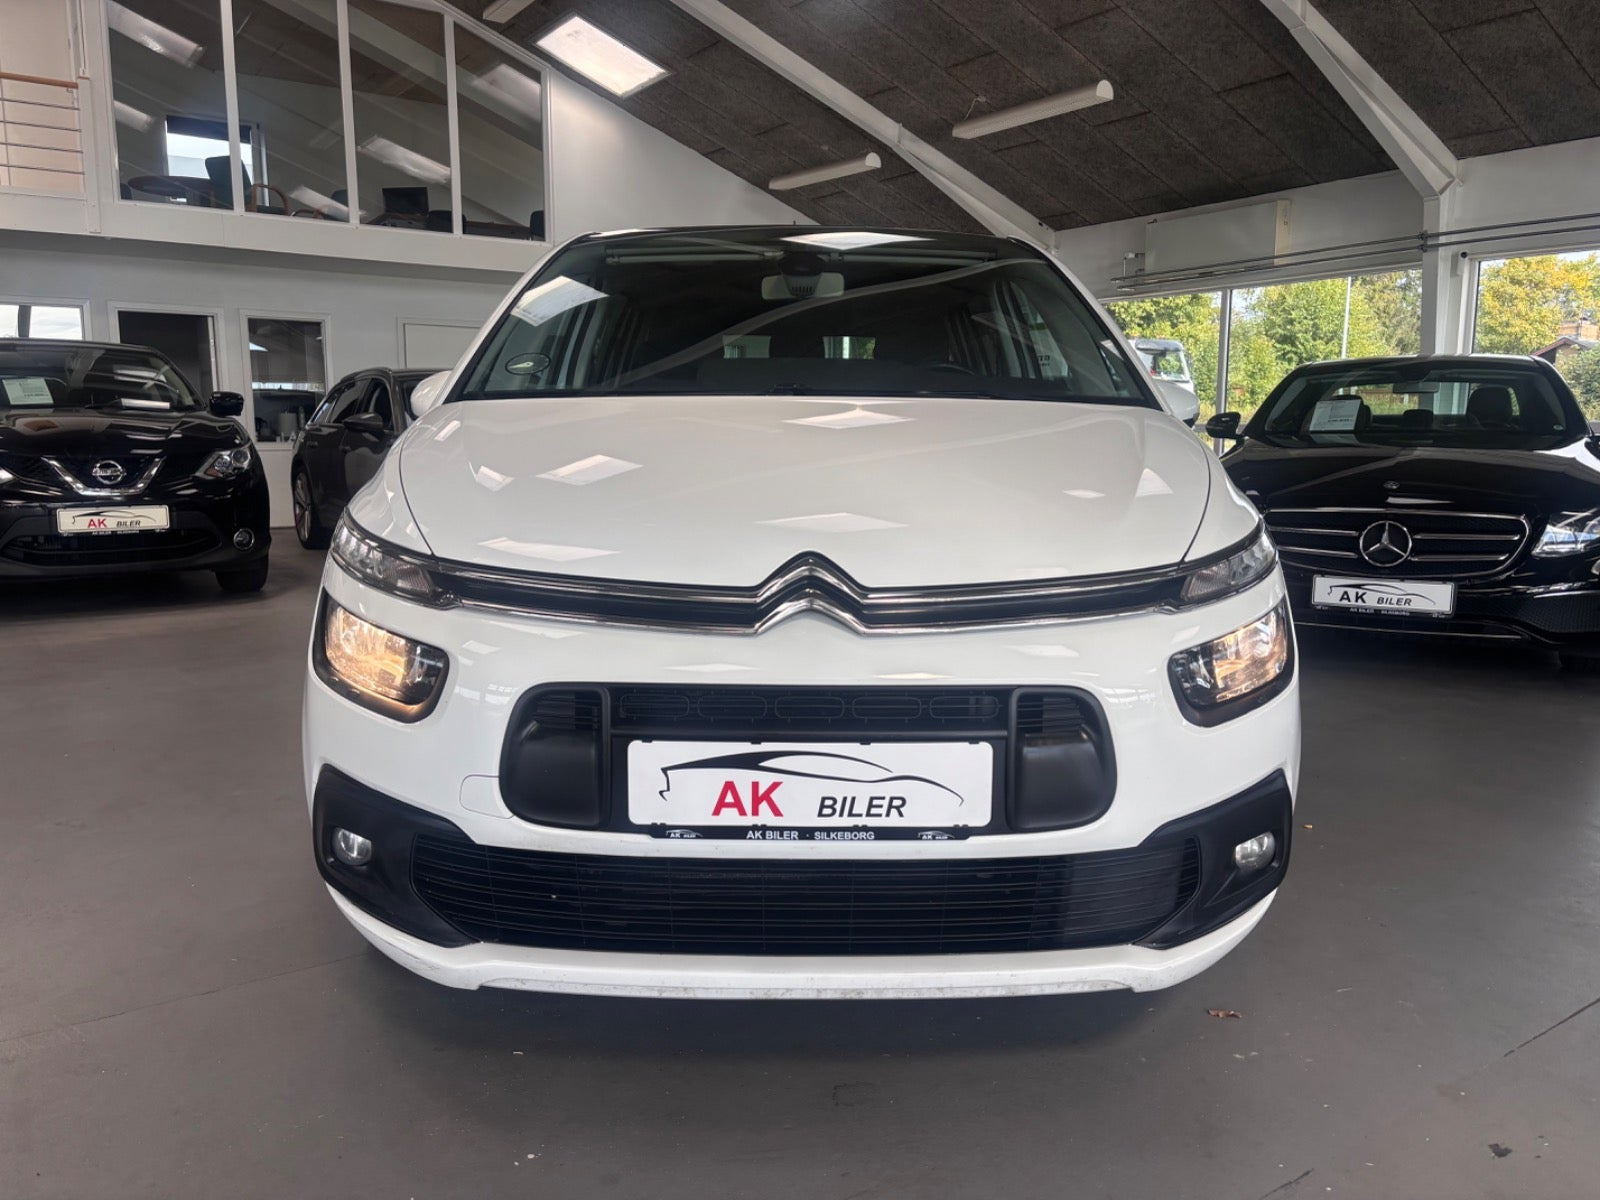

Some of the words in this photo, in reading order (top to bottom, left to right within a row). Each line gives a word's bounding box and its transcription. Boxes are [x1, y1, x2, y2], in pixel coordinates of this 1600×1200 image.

[87, 518, 107, 529] AK
[116, 520, 141, 528] BILER
[1339, 590, 1367, 604] AK
[1376, 596, 1413, 607] BILER
[711, 780, 784, 818] AK
[816, 795, 907, 818] BILER
[746, 829, 763, 840] AK
[765, 830, 799, 841] BILER
[813, 831, 875, 841] SILKEBORG
